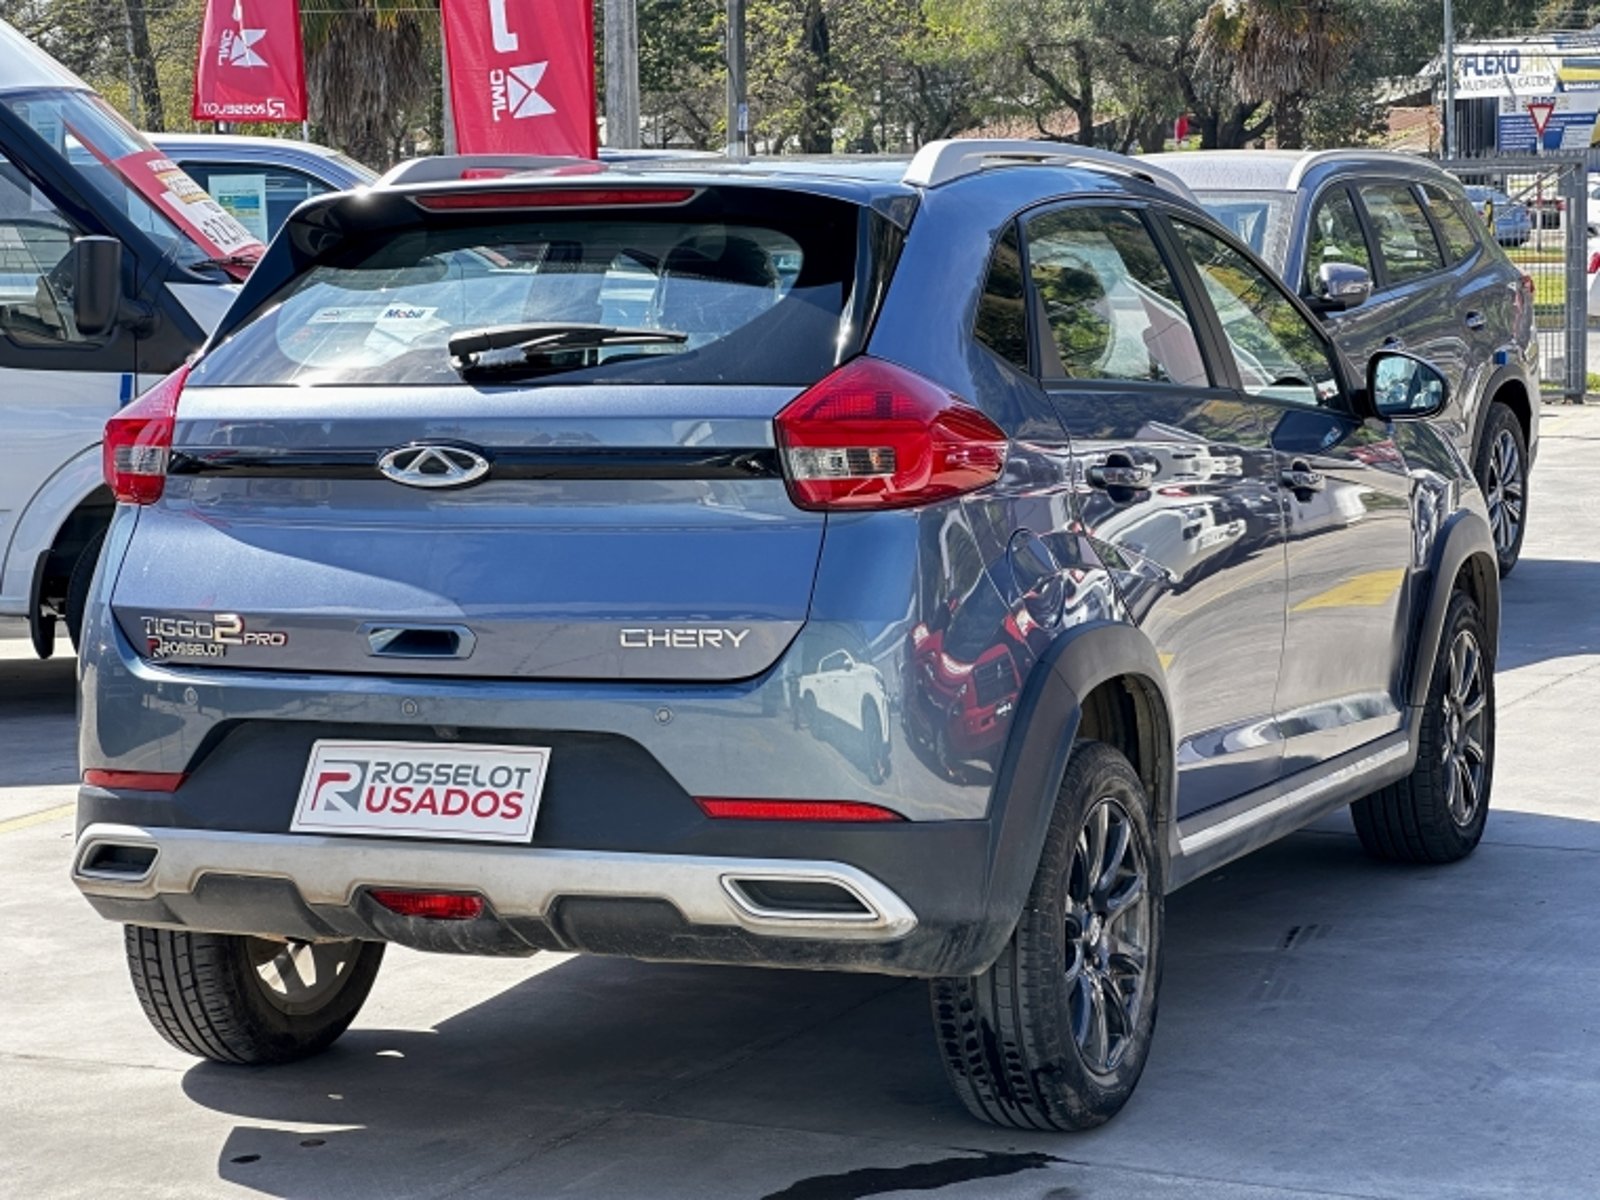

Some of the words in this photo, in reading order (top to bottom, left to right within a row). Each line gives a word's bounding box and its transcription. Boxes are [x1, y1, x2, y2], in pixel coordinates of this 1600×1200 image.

[384, 308, 426, 319] Mobil
[140, 616, 213, 639] TIGGO
[213, 613, 243, 646] 2
[243, 633, 287, 646] PRO
[619, 628, 751, 648] CHERY
[162, 640, 226, 657] ROSSELOT
[371, 761, 532, 790] ROSSELOT
[364, 785, 525, 820] USADOS
